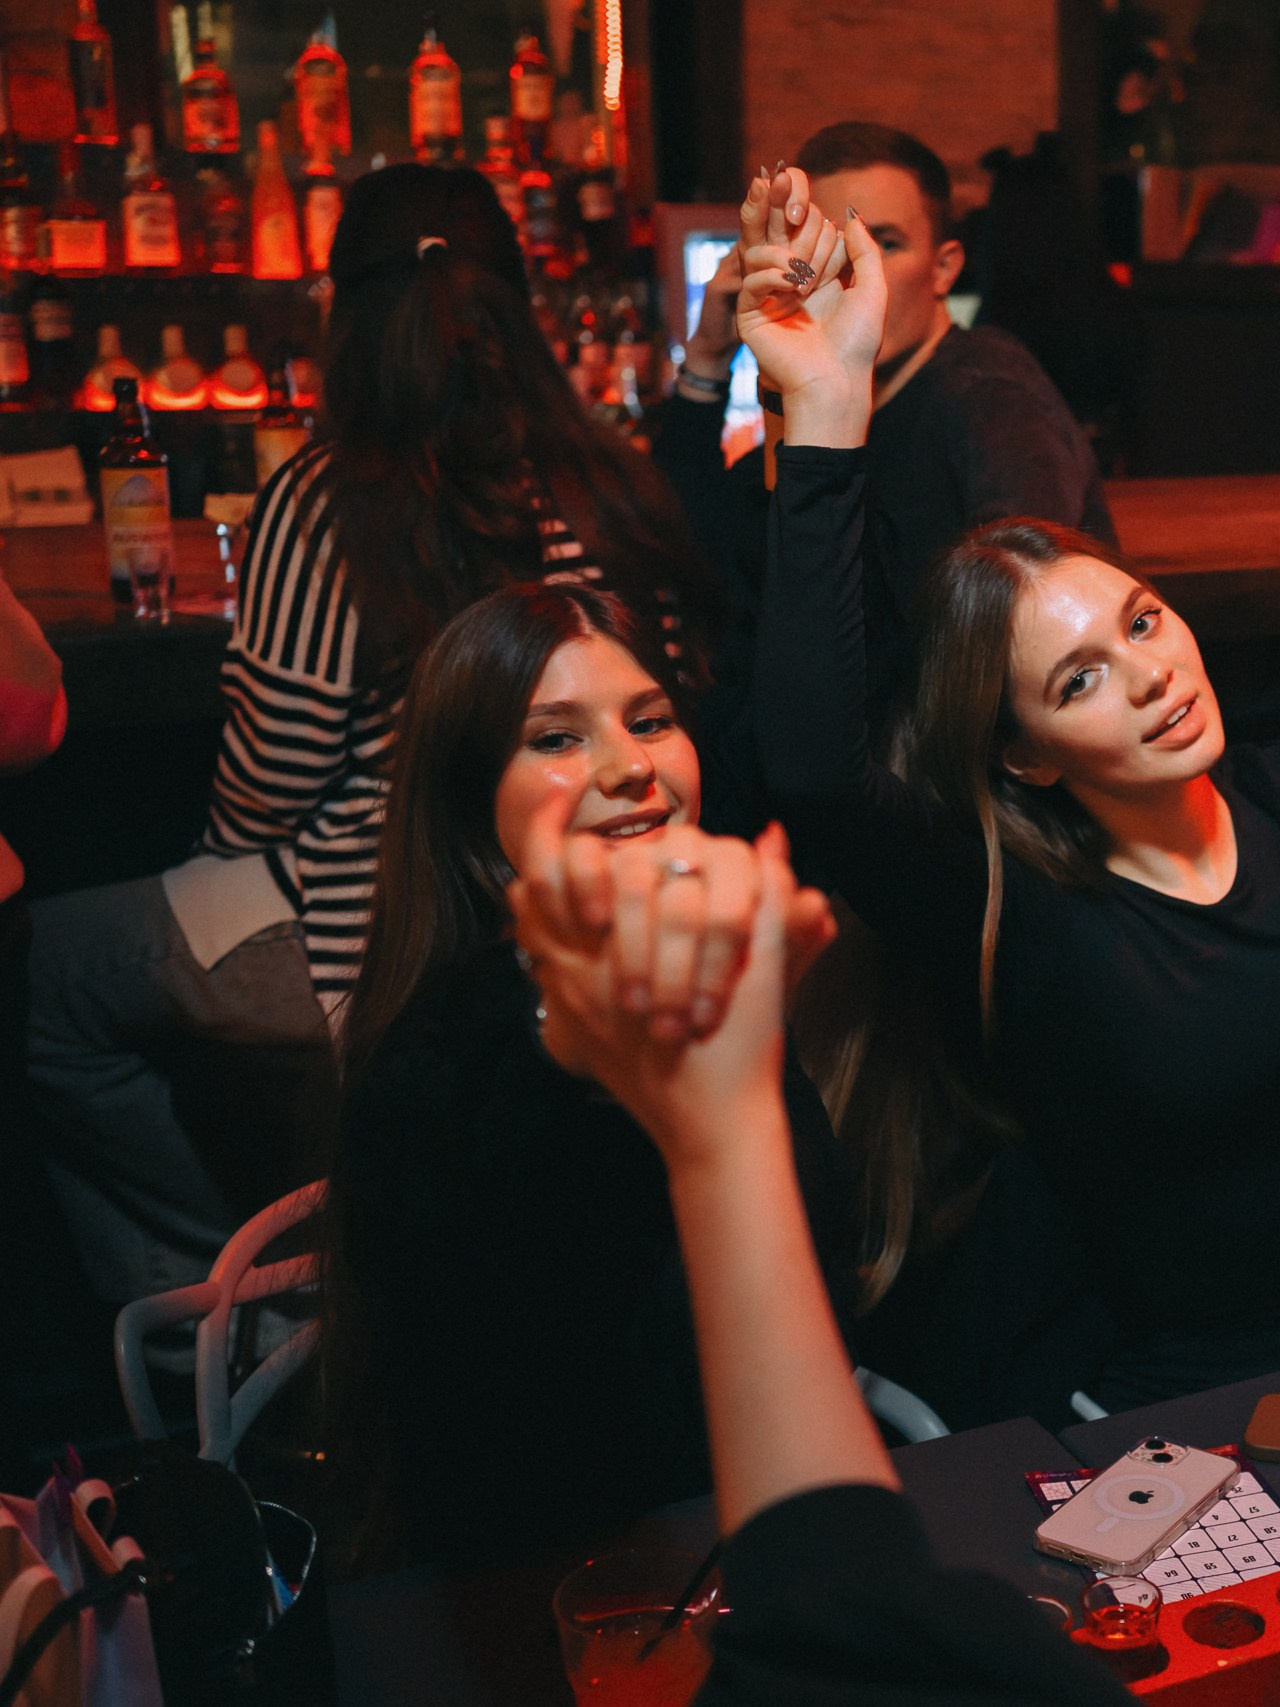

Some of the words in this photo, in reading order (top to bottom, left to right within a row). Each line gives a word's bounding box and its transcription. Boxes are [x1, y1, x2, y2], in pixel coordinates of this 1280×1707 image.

[1249, 1506, 1260, 1514] 57
[1264, 1526, 1278, 1534] 58
[1227, 1534, 1239, 1542] 27
[1188, 1541, 1200, 1549] 81
[1242, 1555, 1257, 1564] 89
[1204, 1562, 1217, 1570] 59
[1164, 1569, 1178, 1578] 64
